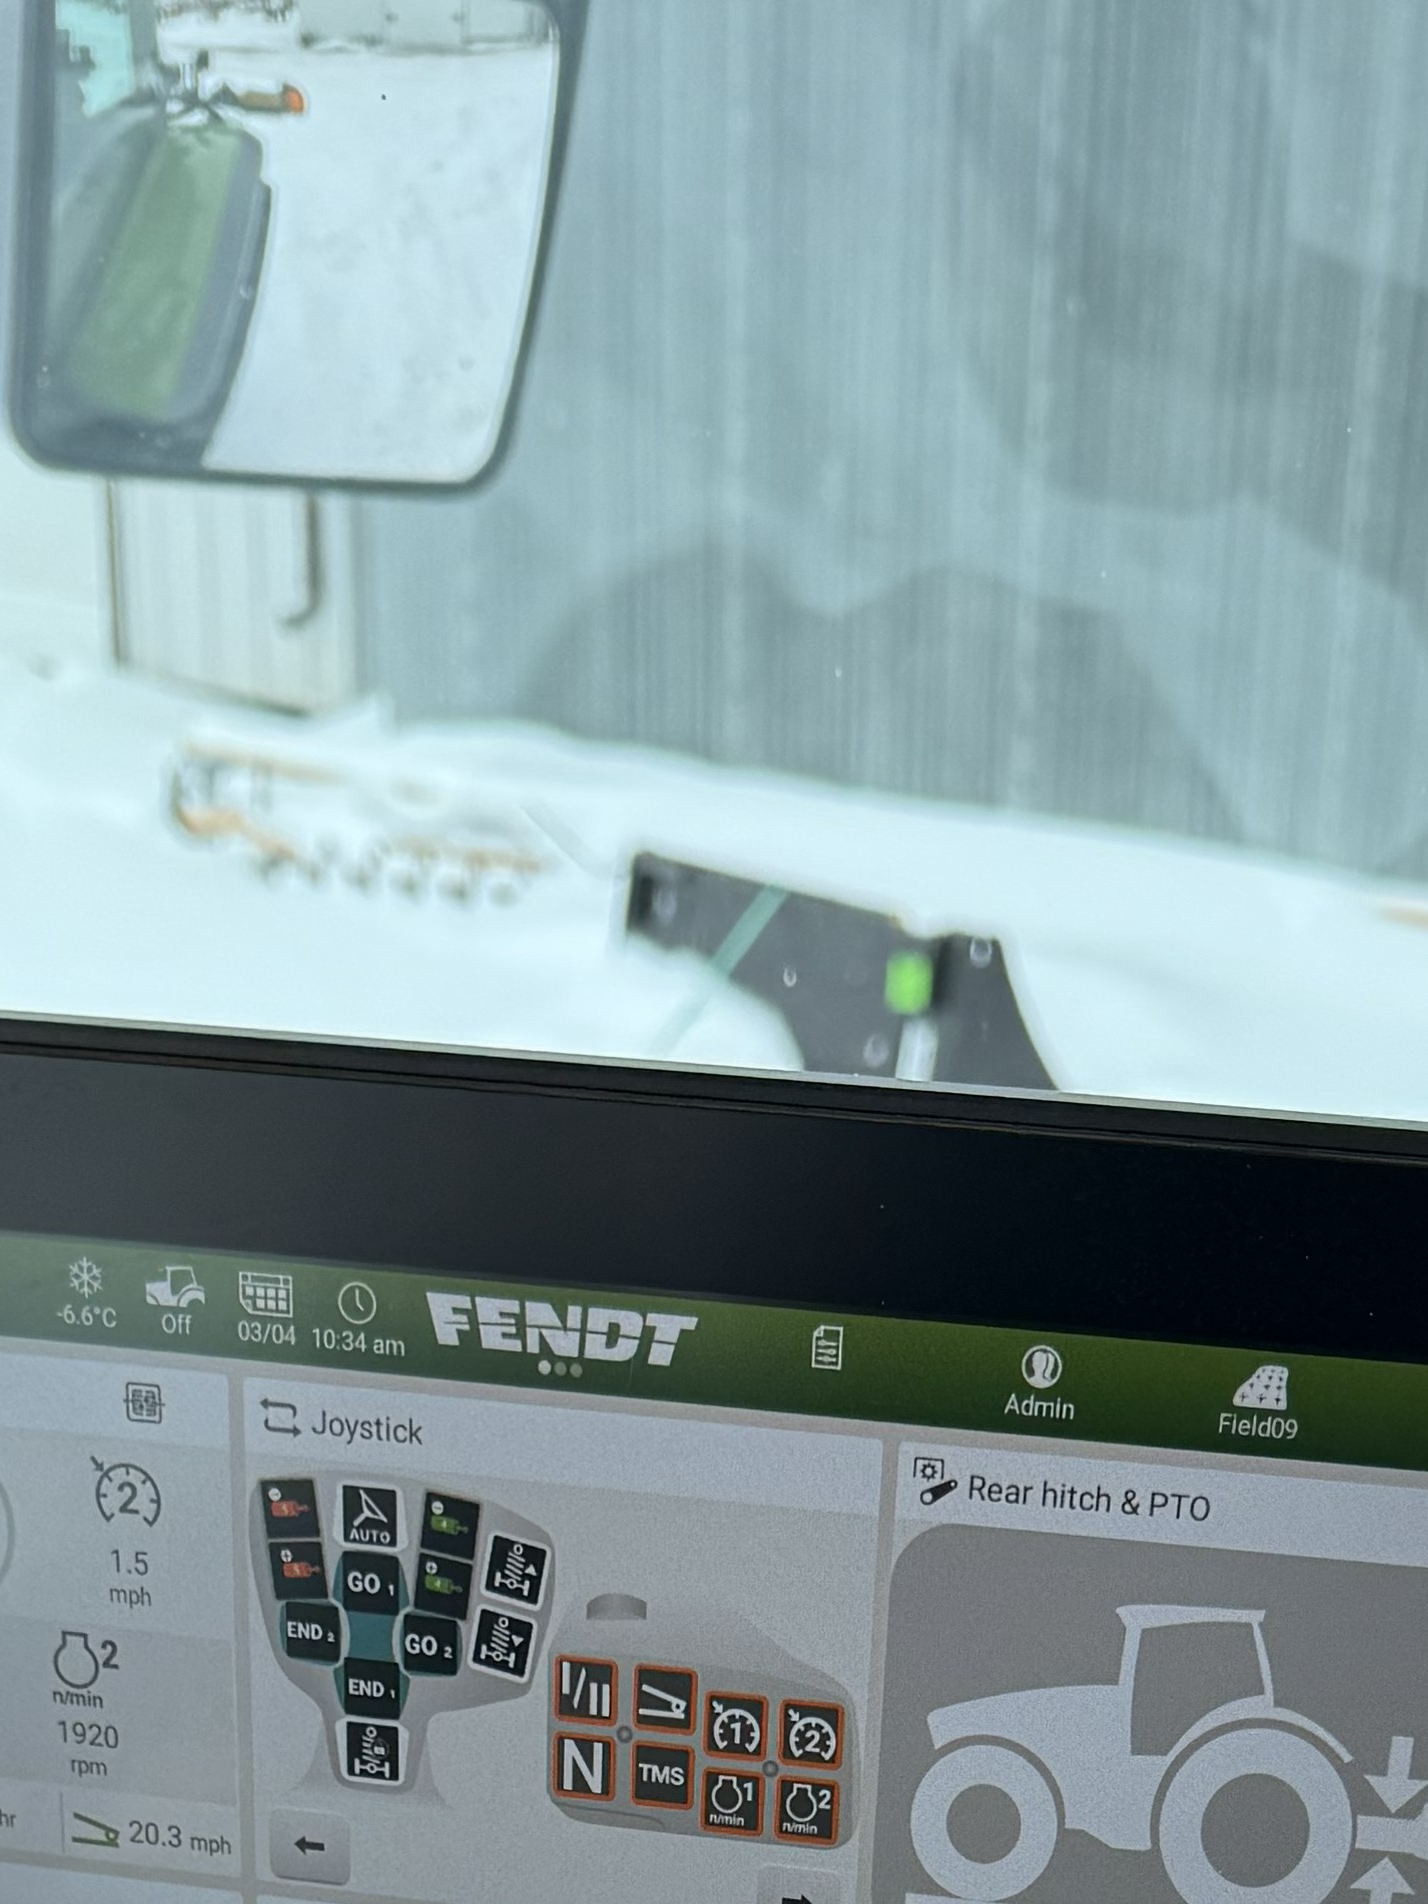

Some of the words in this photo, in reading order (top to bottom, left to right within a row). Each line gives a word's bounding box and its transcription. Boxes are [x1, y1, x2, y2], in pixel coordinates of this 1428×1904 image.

[56, 1306, 117, 1328] -6.6°C
[162, 1314, 192, 1335] Off
[238, 1321, 296, 1346] 03/04
[426, 1292, 698, 1367] FENDT
[312, 1328, 366, 1353] 10:34
[373, 1338, 405, 1356] am
[1004, 1393, 1074, 1420] Admin
[311, 1410, 423, 1446] Joystick
[1218, 1413, 1298, 1439] Field09
[968, 1475, 1034, 1508] Rear
[1041, 1480, 1111, 1515] hitch
[1120, 1489, 1141, 1516] &
[1149, 1491, 1211, 1523] PTO
[349, 1528, 391, 1543] AUTO
[111, 1550, 149, 1576] 1.5
[347, 1572, 380, 1594] GO
[388, 1584, 394, 1595] 1
[110, 1586, 152, 1607] mph
[287, 1621, 323, 1640] END
[327, 1632, 335, 1642] 2
[101, 1640, 120, 1669] 2
[405, 1634, 437, 1656] GO
[444, 1647, 453, 1659] 2
[53, 1690, 104, 1709] n/min
[348, 1678, 384, 1698] END
[58, 1720, 119, 1749] 1920
[71, 1759, 107, 1777] rpm
[563, 1738, 603, 1794] N
[638, 1763, 684, 1786] TMS
[818, 1790, 831, 1809] 2
[709, 1813, 745, 1827] n/min
[782, 1821, 818, 1835] n/min
[129, 1820, 182, 1849] 20.3
[190, 1835, 232, 1856] mph
